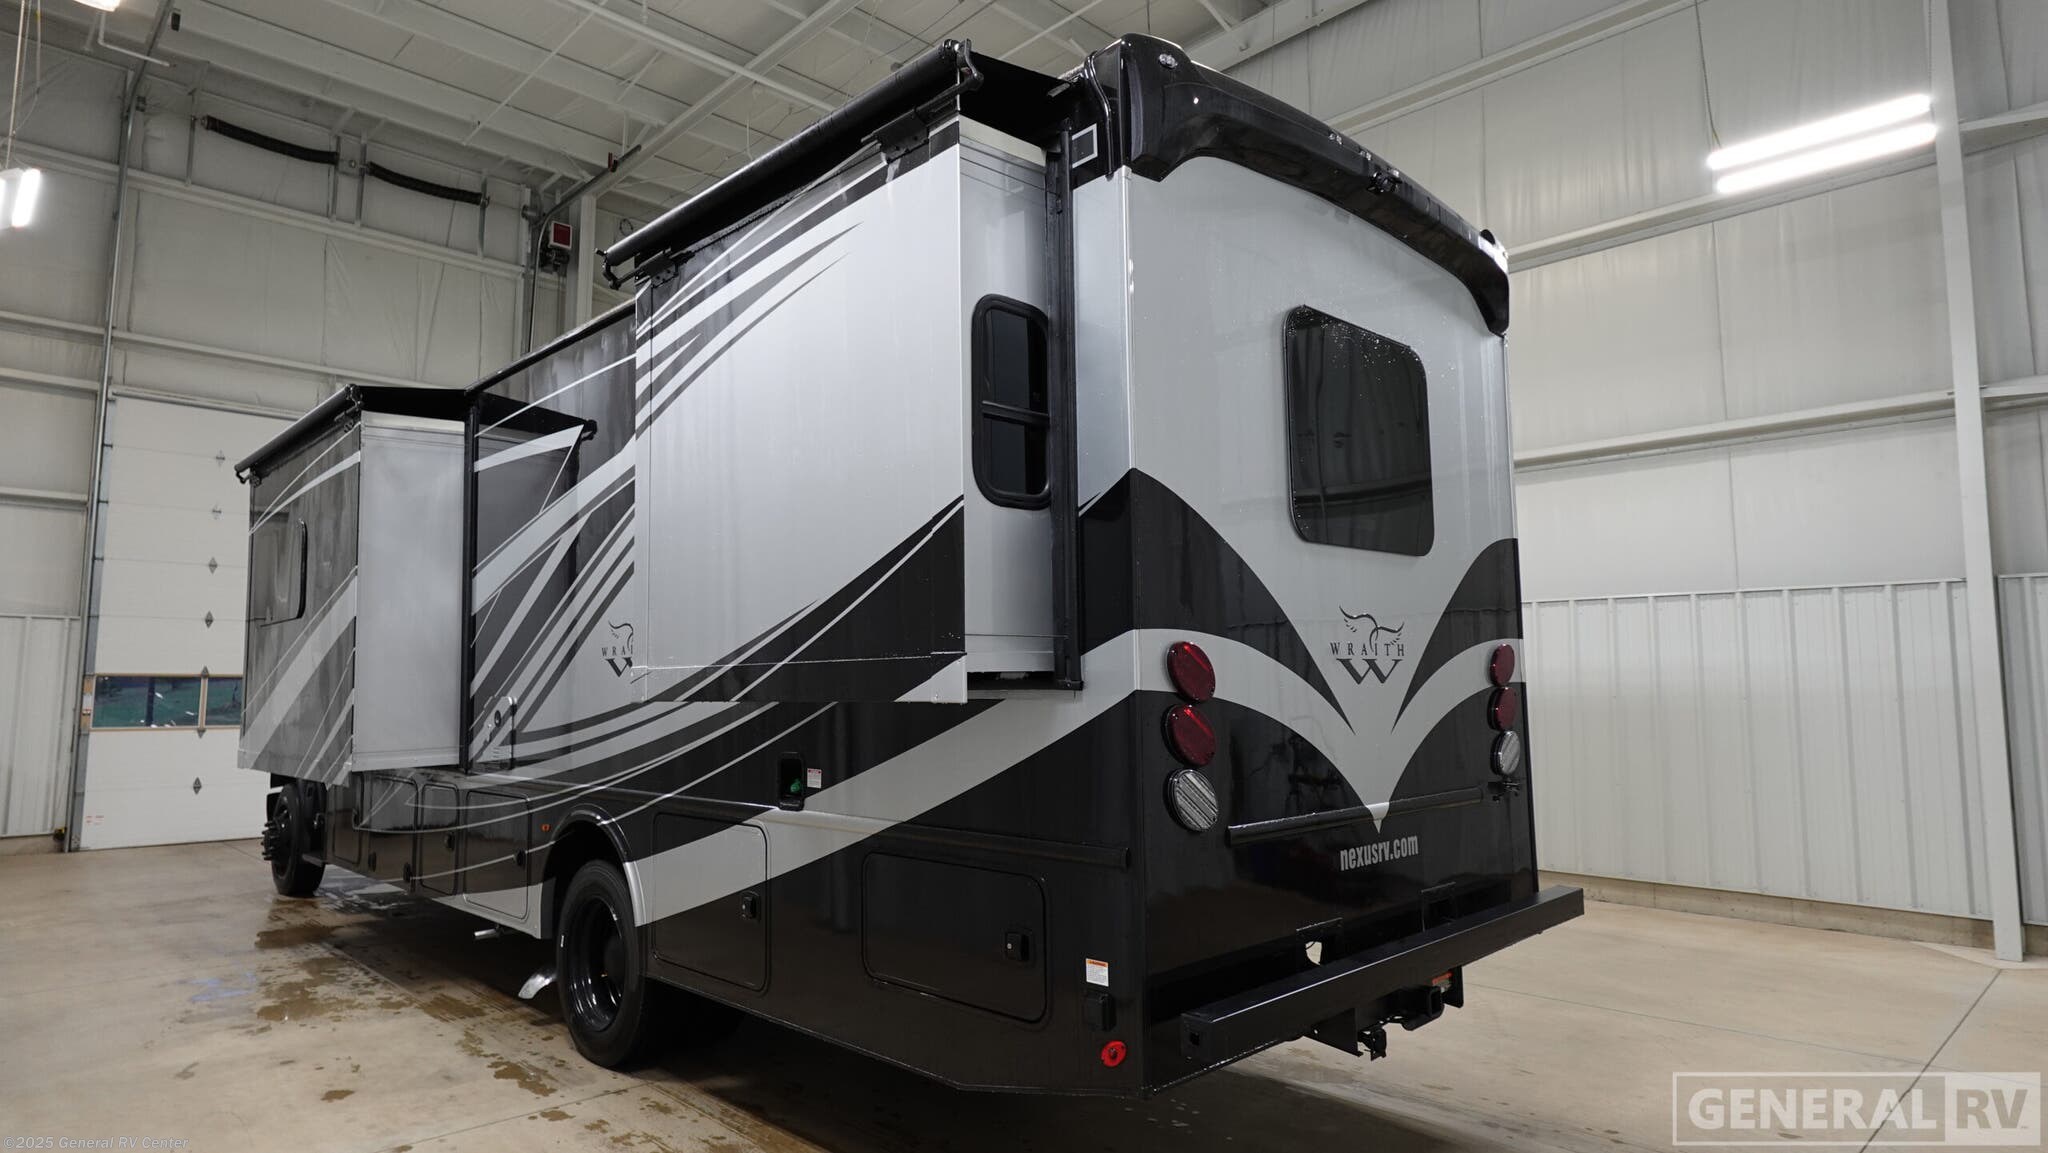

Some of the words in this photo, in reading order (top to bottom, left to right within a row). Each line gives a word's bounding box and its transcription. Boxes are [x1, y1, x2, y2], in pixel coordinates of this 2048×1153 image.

[601, 645, 633, 657] WRAI
[1329, 641, 1405, 657] WRAITH
[1335, 657, 1403, 685] W
[1340, 835, 1419, 872] nexusrv.com
